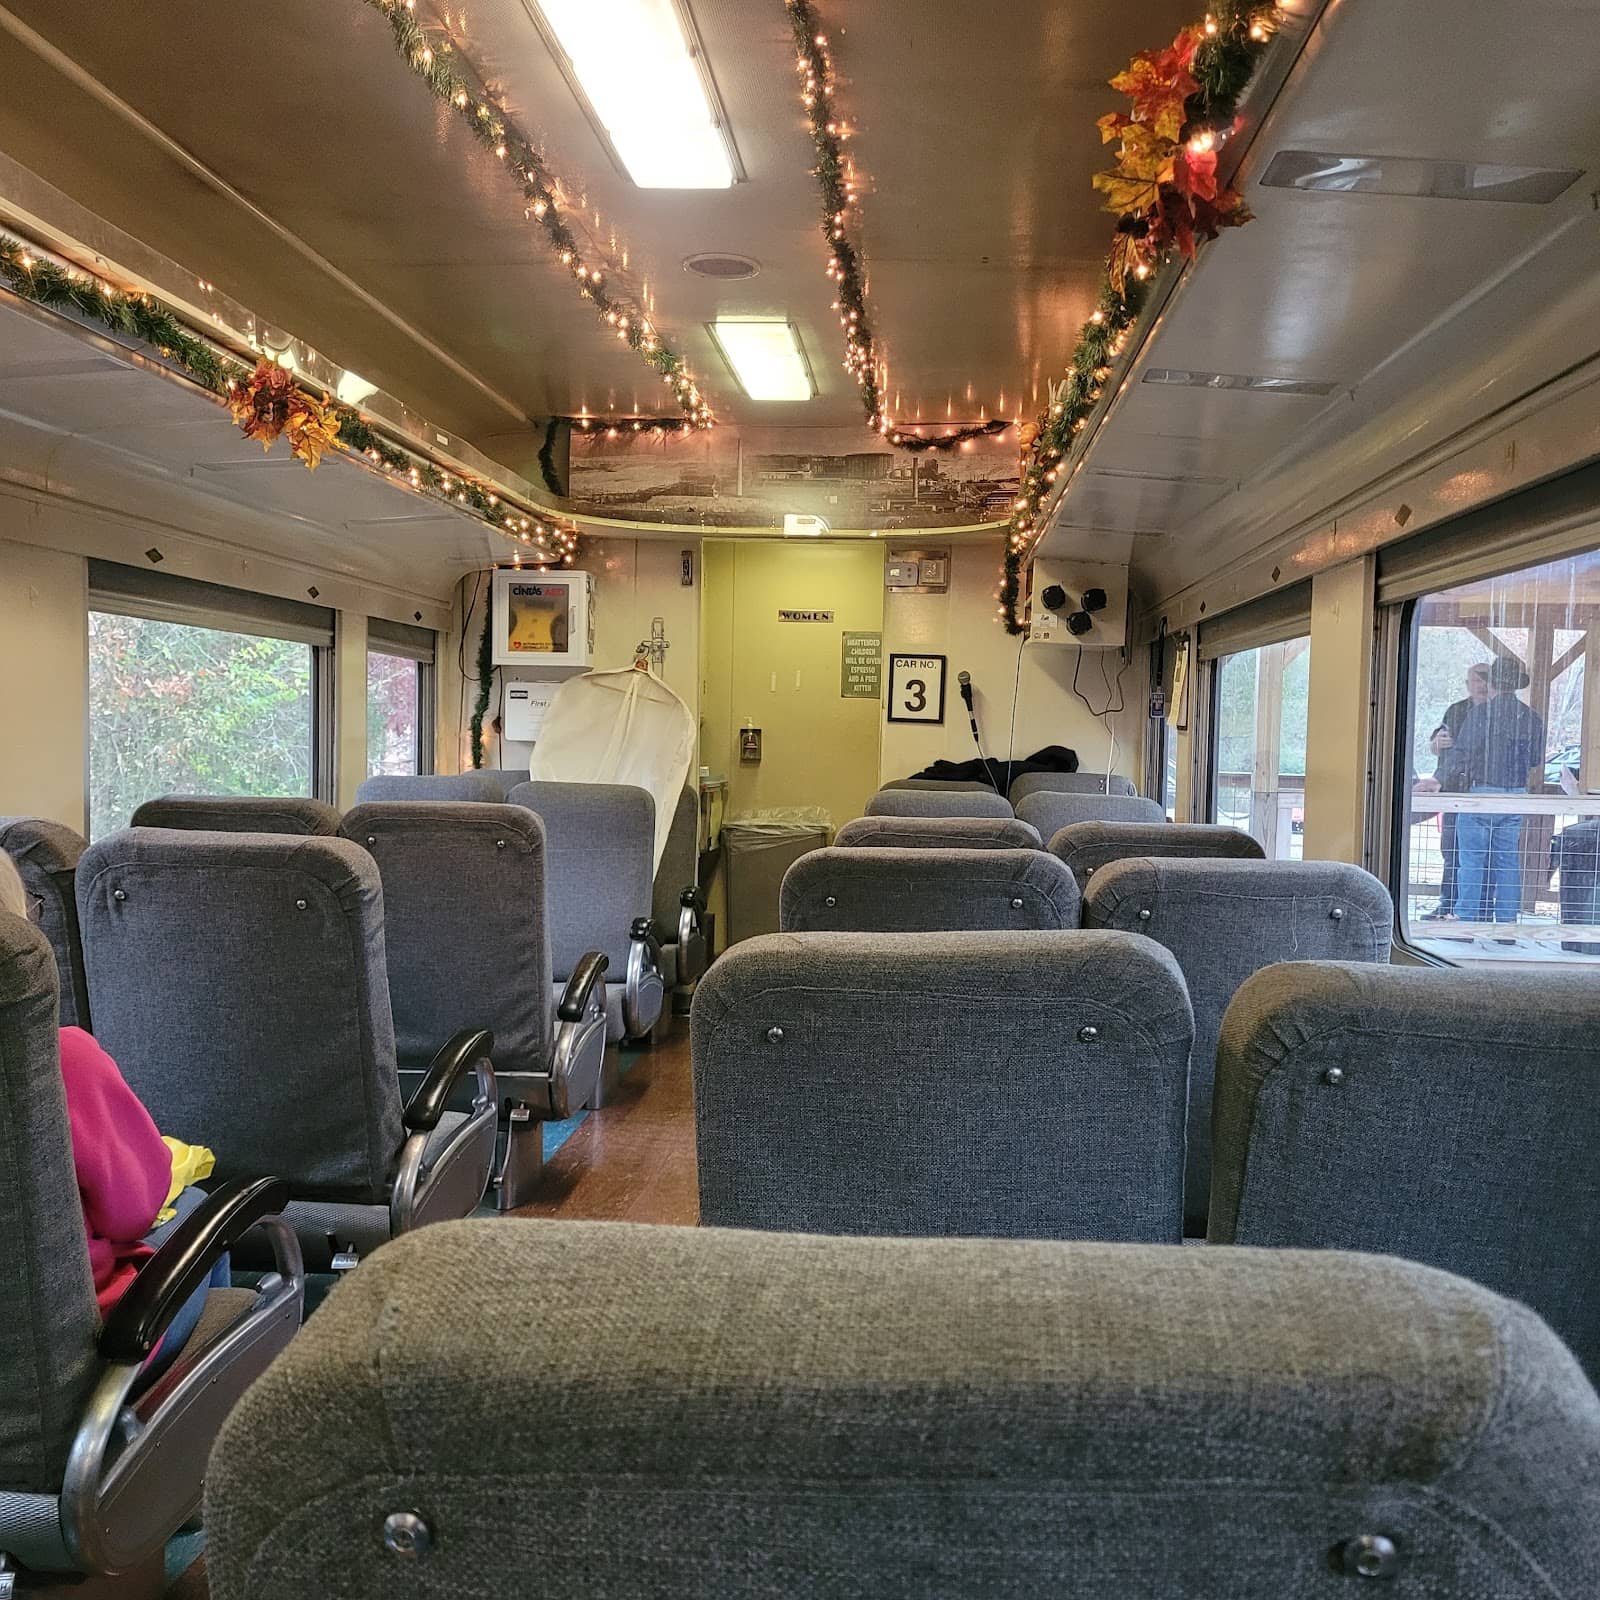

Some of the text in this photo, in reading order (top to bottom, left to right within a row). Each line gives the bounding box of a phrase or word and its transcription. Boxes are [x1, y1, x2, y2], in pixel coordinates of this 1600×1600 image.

[782, 612, 829, 621] WOMEN
[846, 639, 881, 647] UNATTENDED
[850, 647, 876, 656] CHILDREN
[895, 659, 937, 670] CAR NO.
[850, 666, 876, 674] ESPRESSO
[847, 675, 878, 683] AND A FREE
[853, 684, 872, 692] KITTEN
[904, 679, 927, 712] 3
